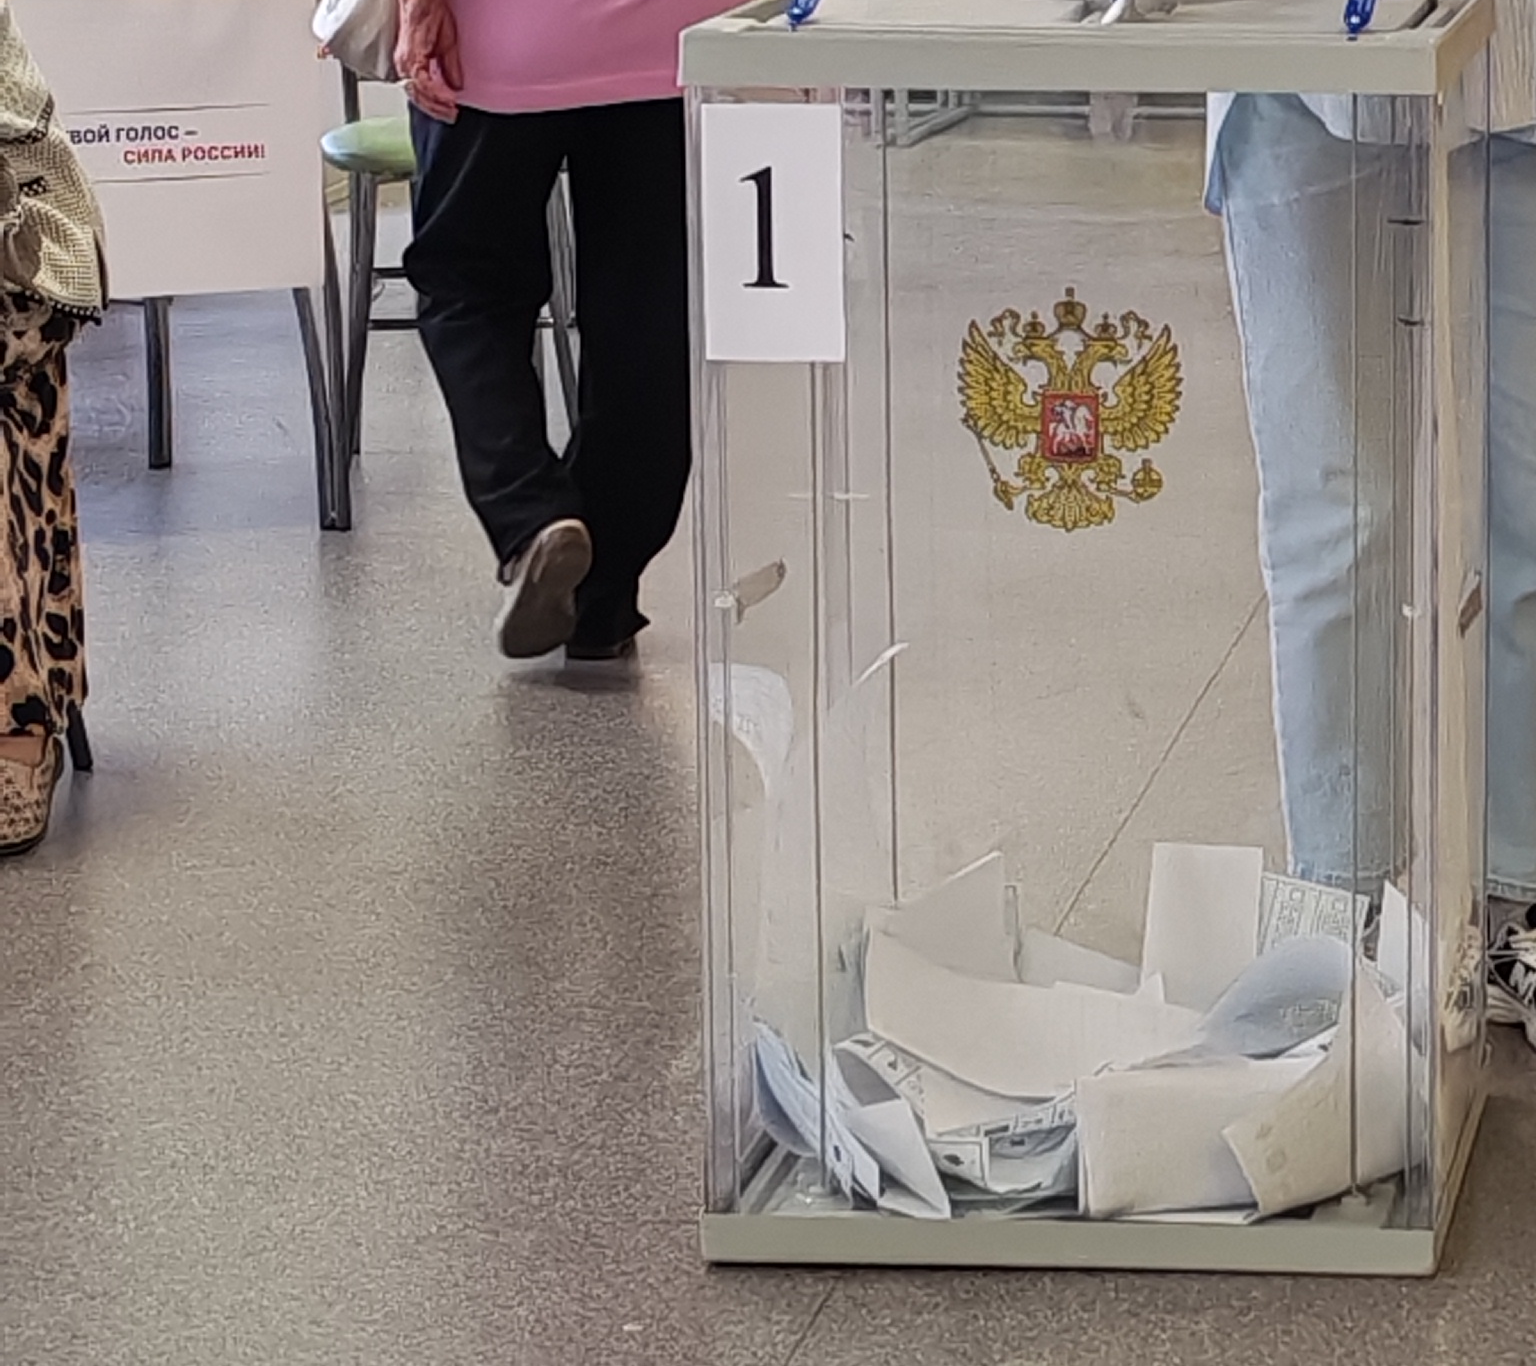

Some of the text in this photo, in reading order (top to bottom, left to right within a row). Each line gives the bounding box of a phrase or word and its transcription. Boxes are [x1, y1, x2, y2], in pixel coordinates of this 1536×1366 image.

[115, 125, 180, 143] ГОЛОС
[123, 144, 265, 165] СИЛА РОССИИ!
[739, 166, 789, 288] 1
